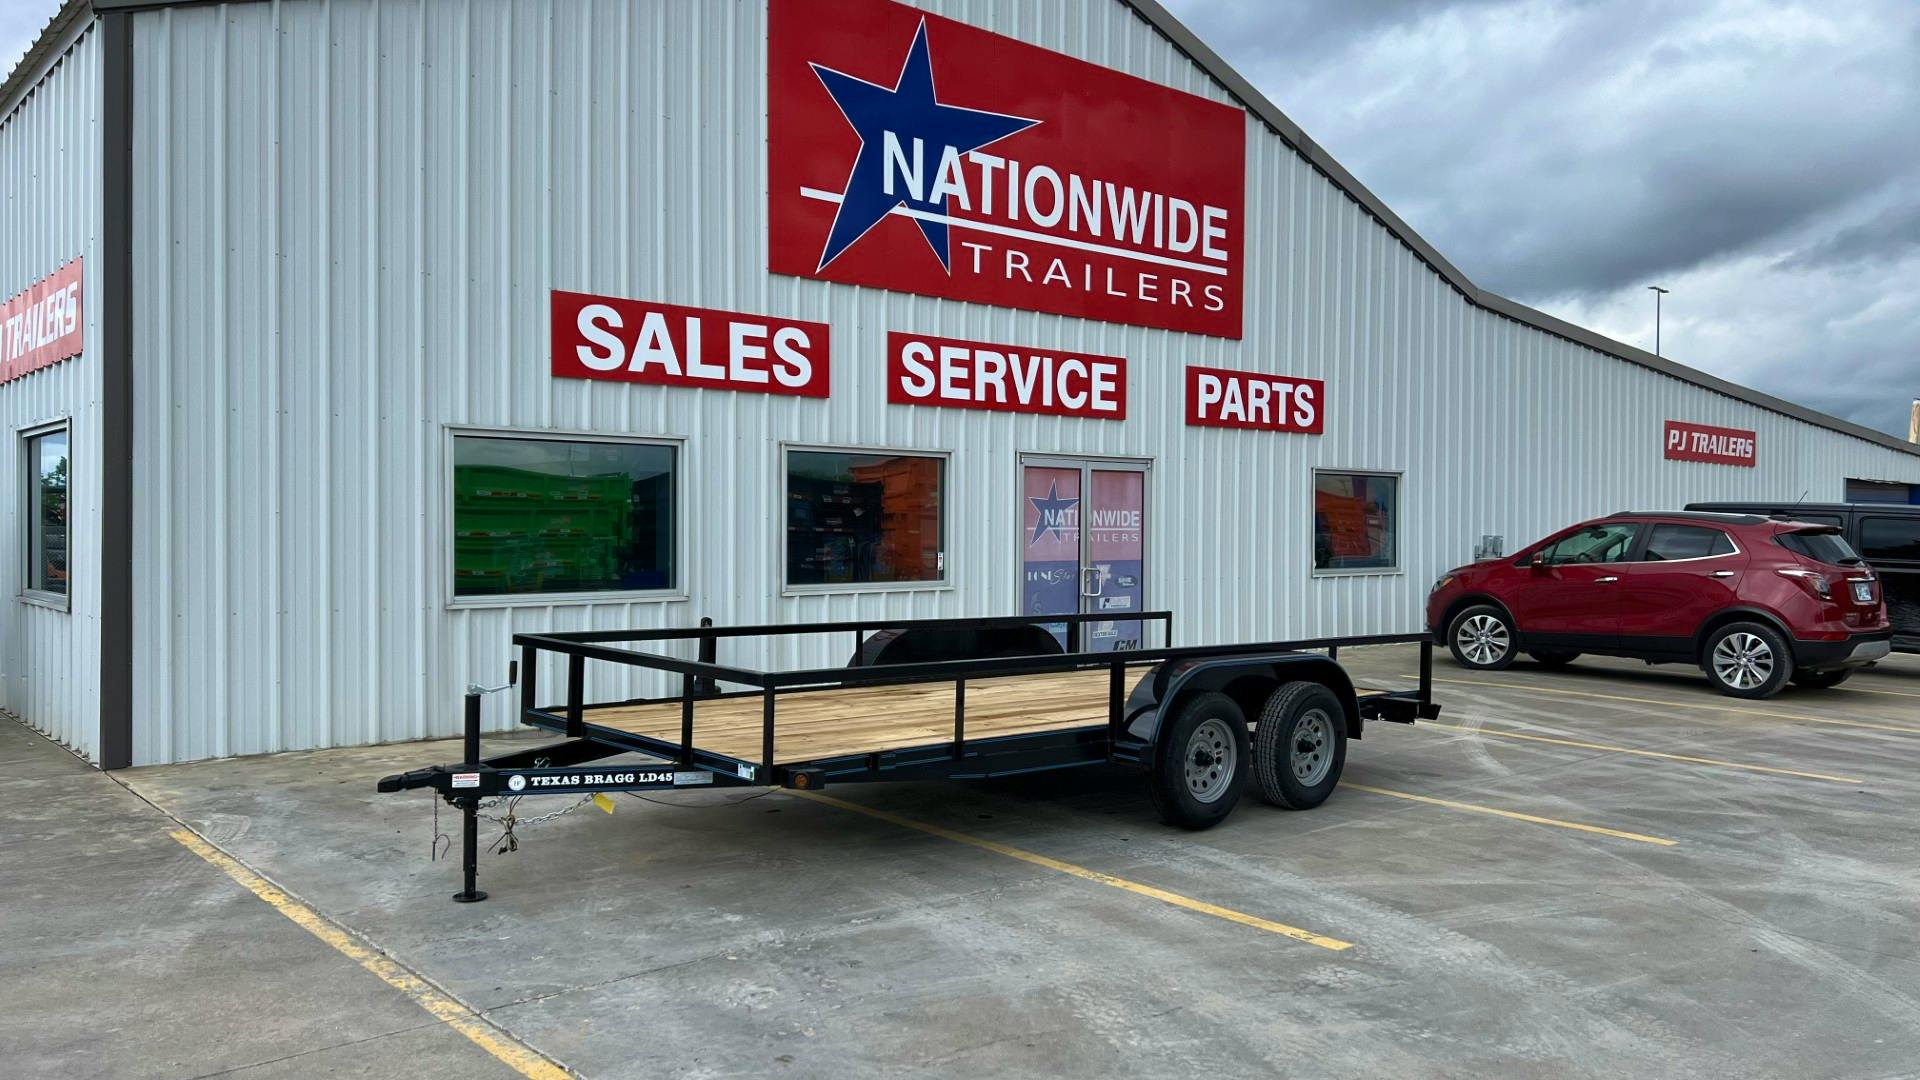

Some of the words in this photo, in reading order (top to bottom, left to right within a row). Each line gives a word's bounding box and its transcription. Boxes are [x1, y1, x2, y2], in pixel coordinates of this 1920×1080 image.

[883, 130, 1228, 261] NATIONWIDE
[961, 241, 1225, 312] TRAILERS
[6, 281, 78, 362] TRAILERS
[576, 304, 812, 387] SALES
[901, 341, 1117, 411] SERVICE
[1198, 374, 1315, 428] PARTS
[1668, 429, 1687, 451] PJ
[1691, 432, 1754, 458] TRAILERS
[1044, 508, 1140, 527] NATINWIDE
[531, 775, 580, 786] TEXAS
[584, 774, 635, 785] BRAGG
[639, 772, 673, 783] LD45
